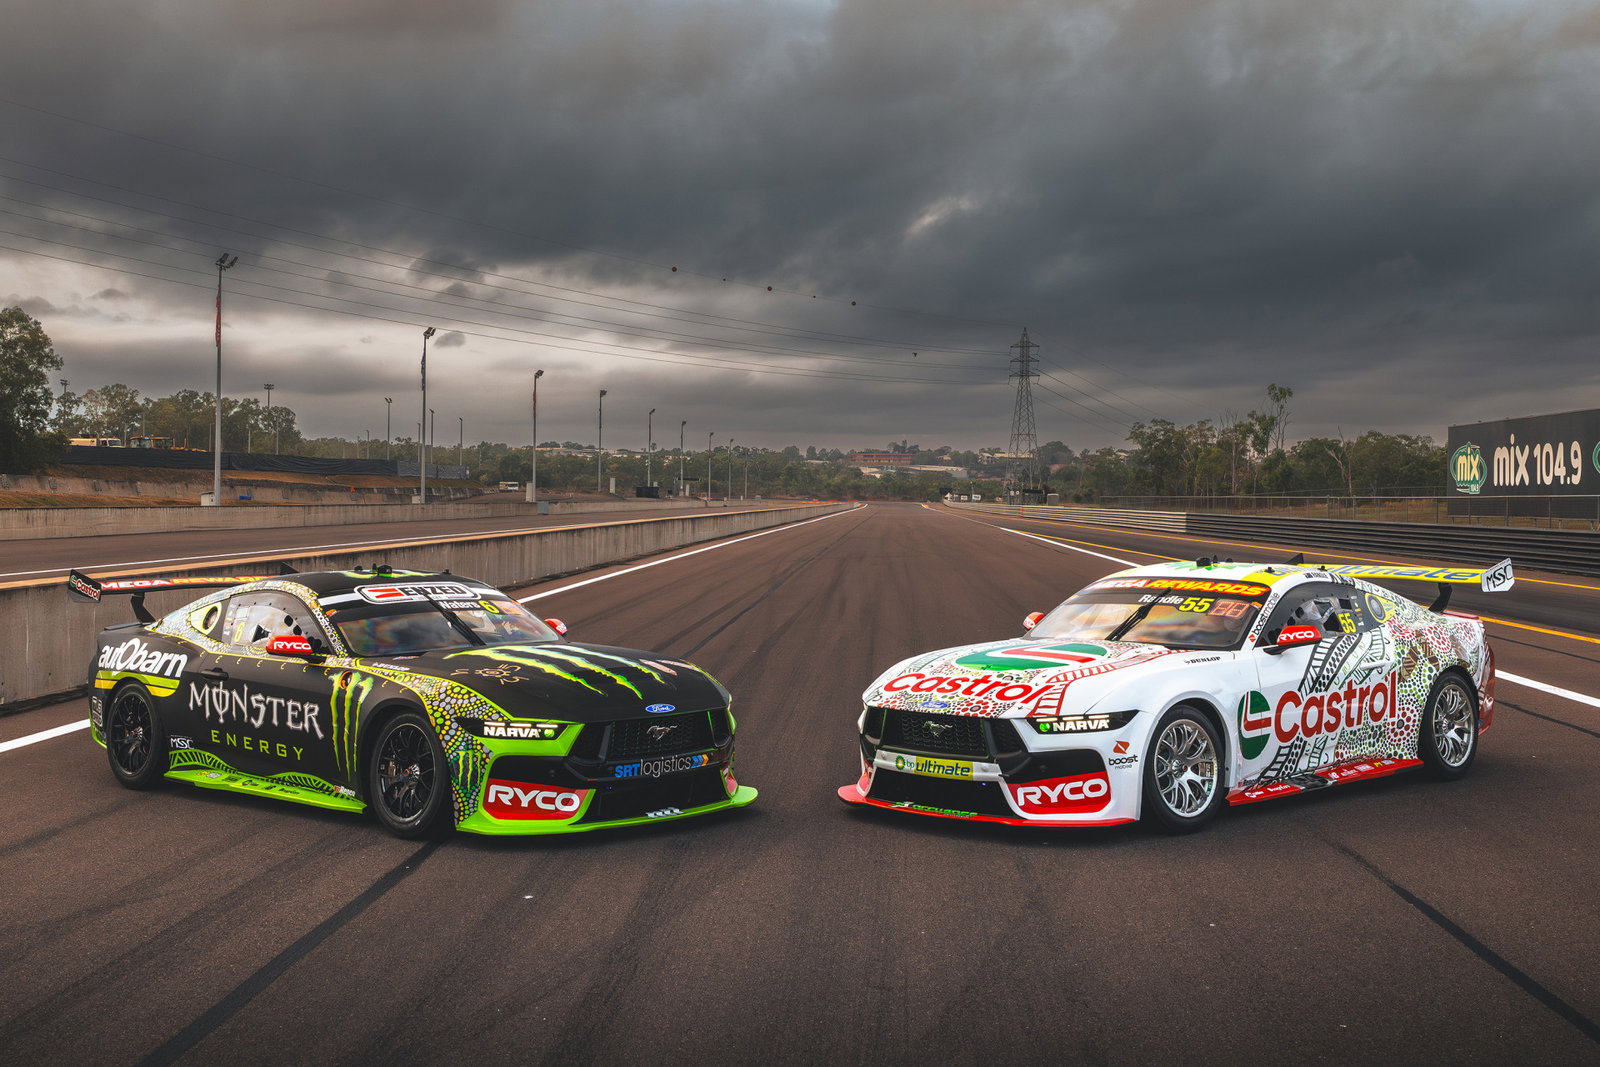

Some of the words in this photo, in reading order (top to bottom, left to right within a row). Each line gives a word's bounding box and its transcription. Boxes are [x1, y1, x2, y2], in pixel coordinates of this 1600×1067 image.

[1457, 446, 1479, 481] mix
[1494, 433, 1530, 486] mix
[1533, 441, 1582, 485] 104.9
[76, 579, 101, 600] Castrol
[101, 580, 171, 589] MEGA
[404, 585, 465, 595] ENZED
[1147, 579, 1269, 595] REWARDS
[479, 600, 500, 613] 6
[1178, 597, 1214, 612] 55
[1338, 613, 1356, 634] 55
[233, 622, 246, 642] 6
[1279, 630, 1314, 641] RYCO
[273, 641, 311, 650] RYCO
[1190, 656, 1221, 664] DUNLOP
[884, 673, 1055, 704] Castrol
[188, 681, 325, 740] MONSTER
[1274, 671, 1396, 743] Castrol
[484, 726, 541, 738] NARVA
[1053, 719, 1110, 731] NARVA
[211, 730, 303, 761] ENERGY
[906, 760, 915, 770] bp
[916, 760, 970, 776] ultimate
[1108, 754, 1138, 766] boost
[488, 785, 580, 812] RYCO
[1017, 778, 1108, 806] RYCO
